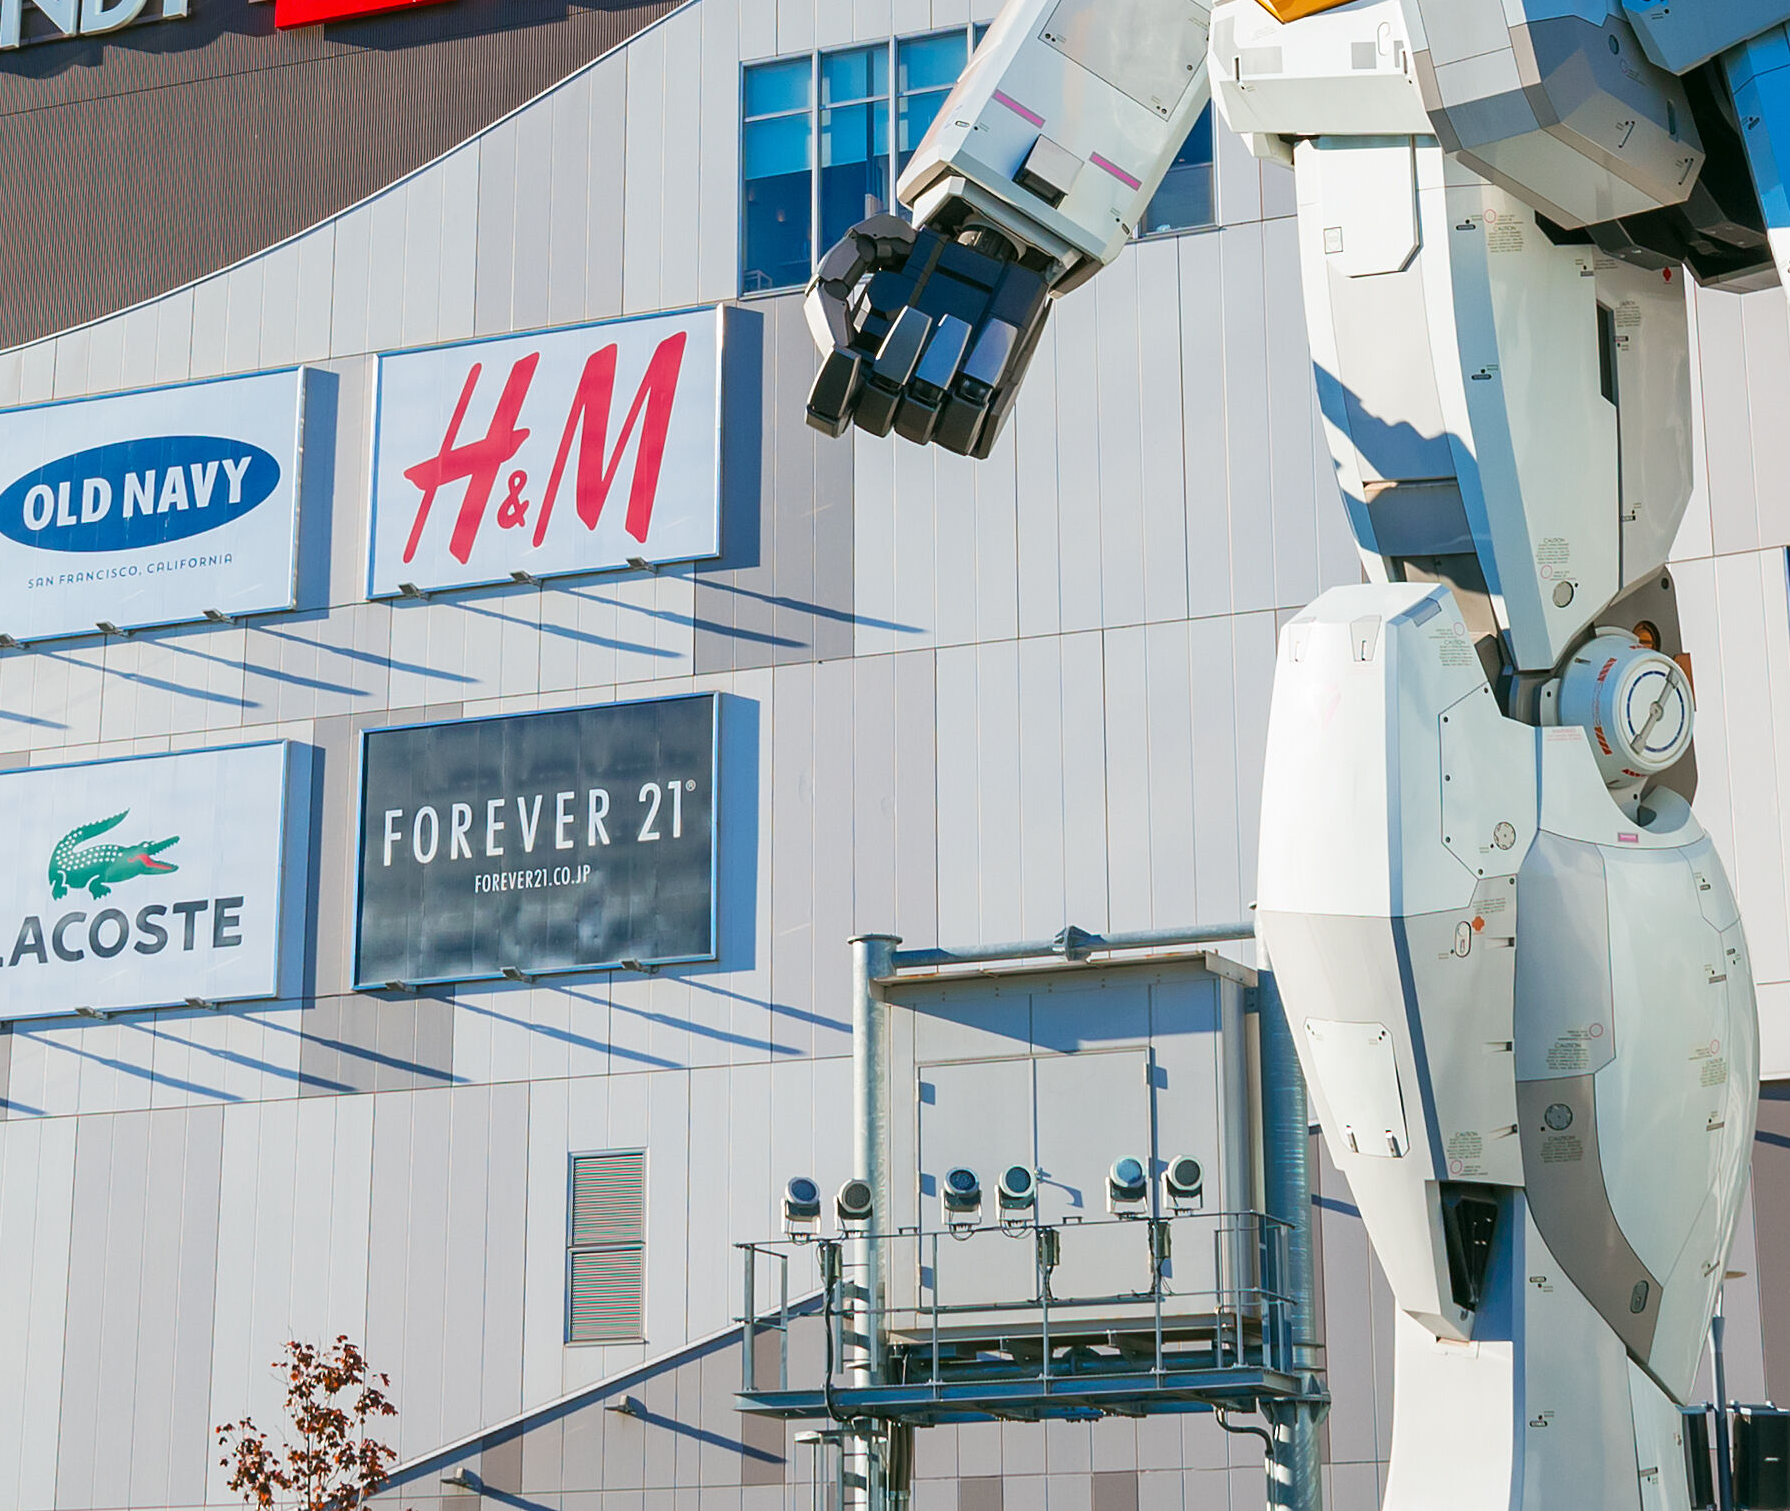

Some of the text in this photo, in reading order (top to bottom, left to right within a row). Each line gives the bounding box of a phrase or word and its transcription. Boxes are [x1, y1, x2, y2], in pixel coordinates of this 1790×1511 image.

[402, 331, 687, 565] H&M
[22, 456, 253, 531] OLD NAVY
[27, 553, 233, 589] SAN FRANCISCO, CALIFORNIA
[383, 789, 611, 867] FOREVER
[474, 865, 592, 894] FOREVER21.CO.JP
